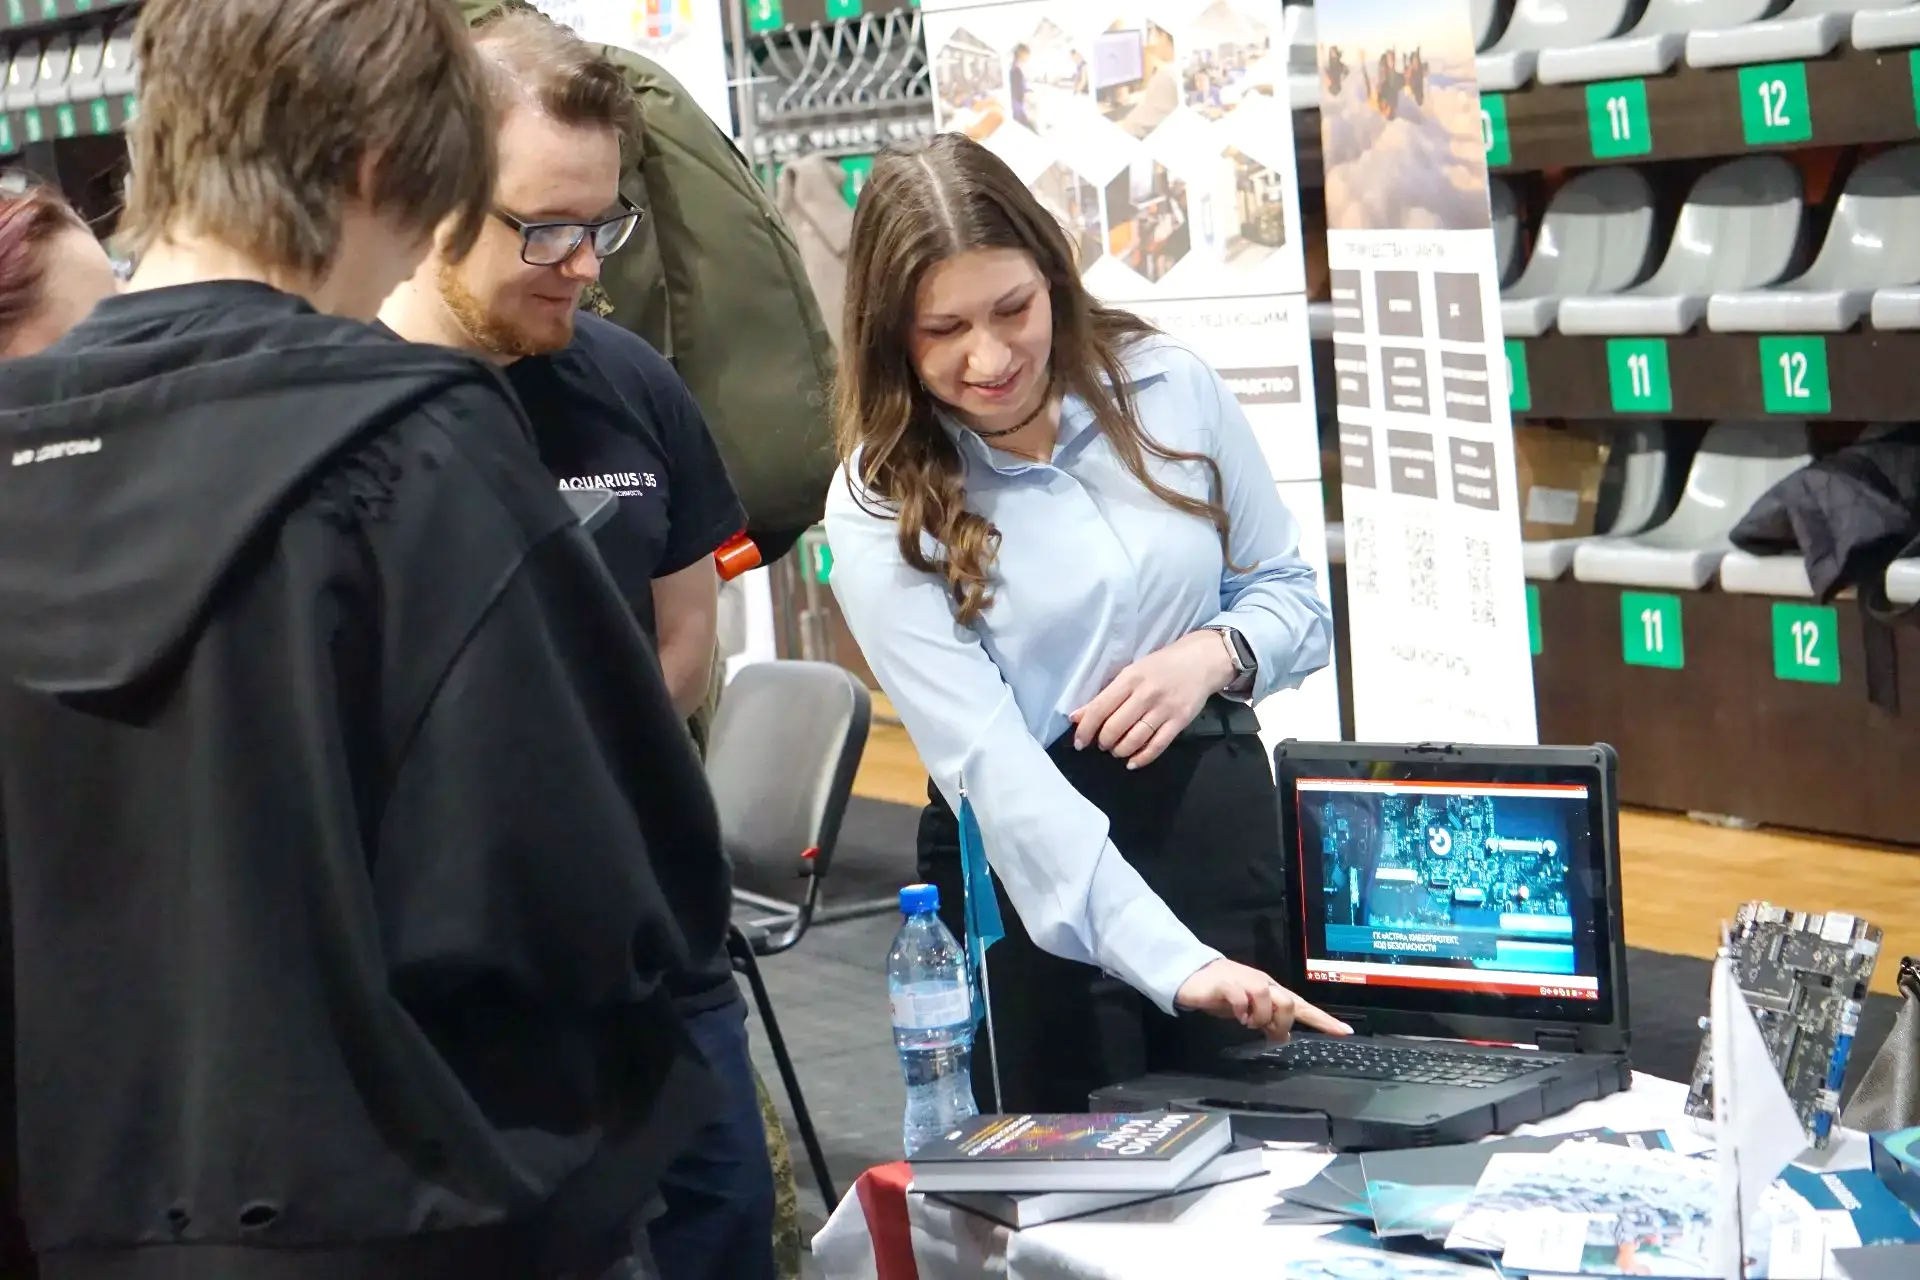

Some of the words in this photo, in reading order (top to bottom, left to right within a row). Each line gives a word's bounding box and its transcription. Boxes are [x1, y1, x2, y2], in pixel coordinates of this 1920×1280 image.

[1605, 95, 1631, 141] 11
[1758, 79, 1791, 127] 12
[1626, 353, 1652, 398] 11
[1778, 351, 1811, 398] 12
[559, 472, 640, 490] AQUARIUS
[643, 472, 657, 488] 35
[1641, 608, 1664, 653] 11
[1791, 620, 1821, 667] 12
[1373, 941, 1387, 951] КОД
[1388, 941, 1437, 952] БЕЗОПАСНОСТИ
